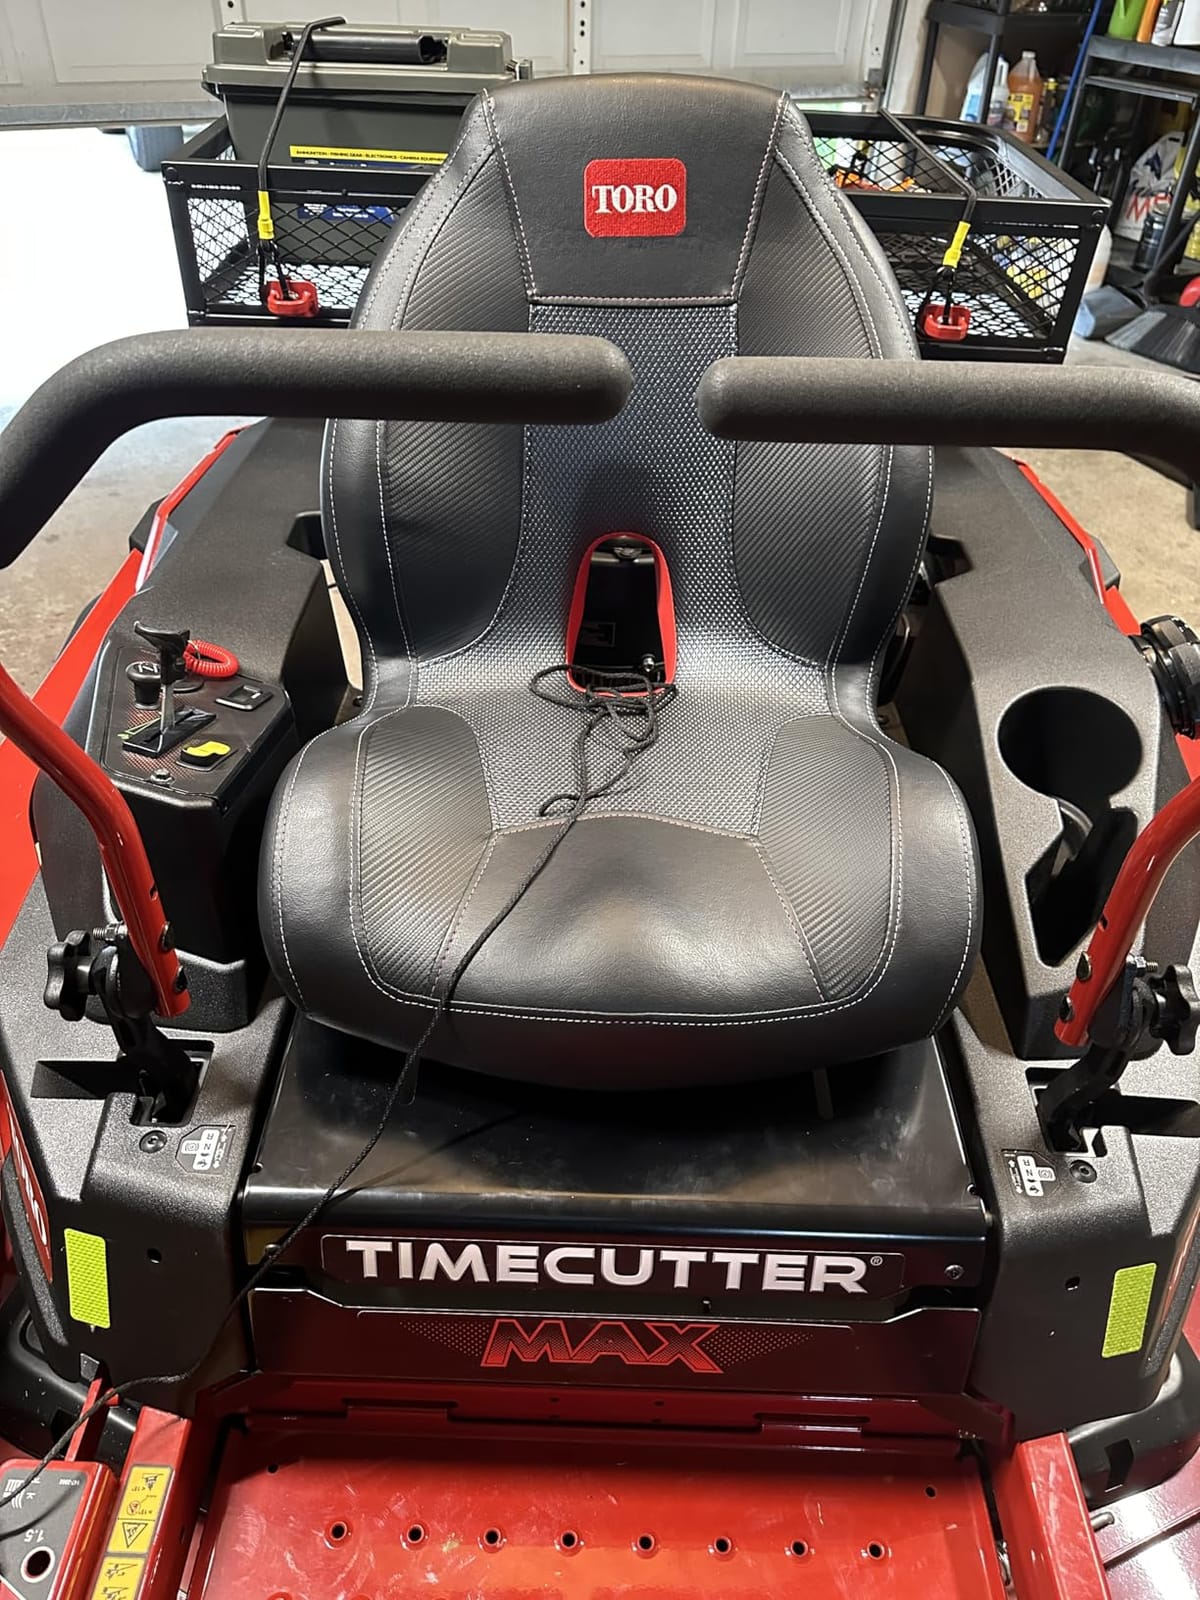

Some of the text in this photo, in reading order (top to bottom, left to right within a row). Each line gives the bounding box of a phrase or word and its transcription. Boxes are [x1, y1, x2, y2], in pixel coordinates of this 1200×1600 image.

[591, 184, 678, 214] TORO
[480, 1318, 724, 1374] MAX
[24, 1528, 44, 1543] 1.5
